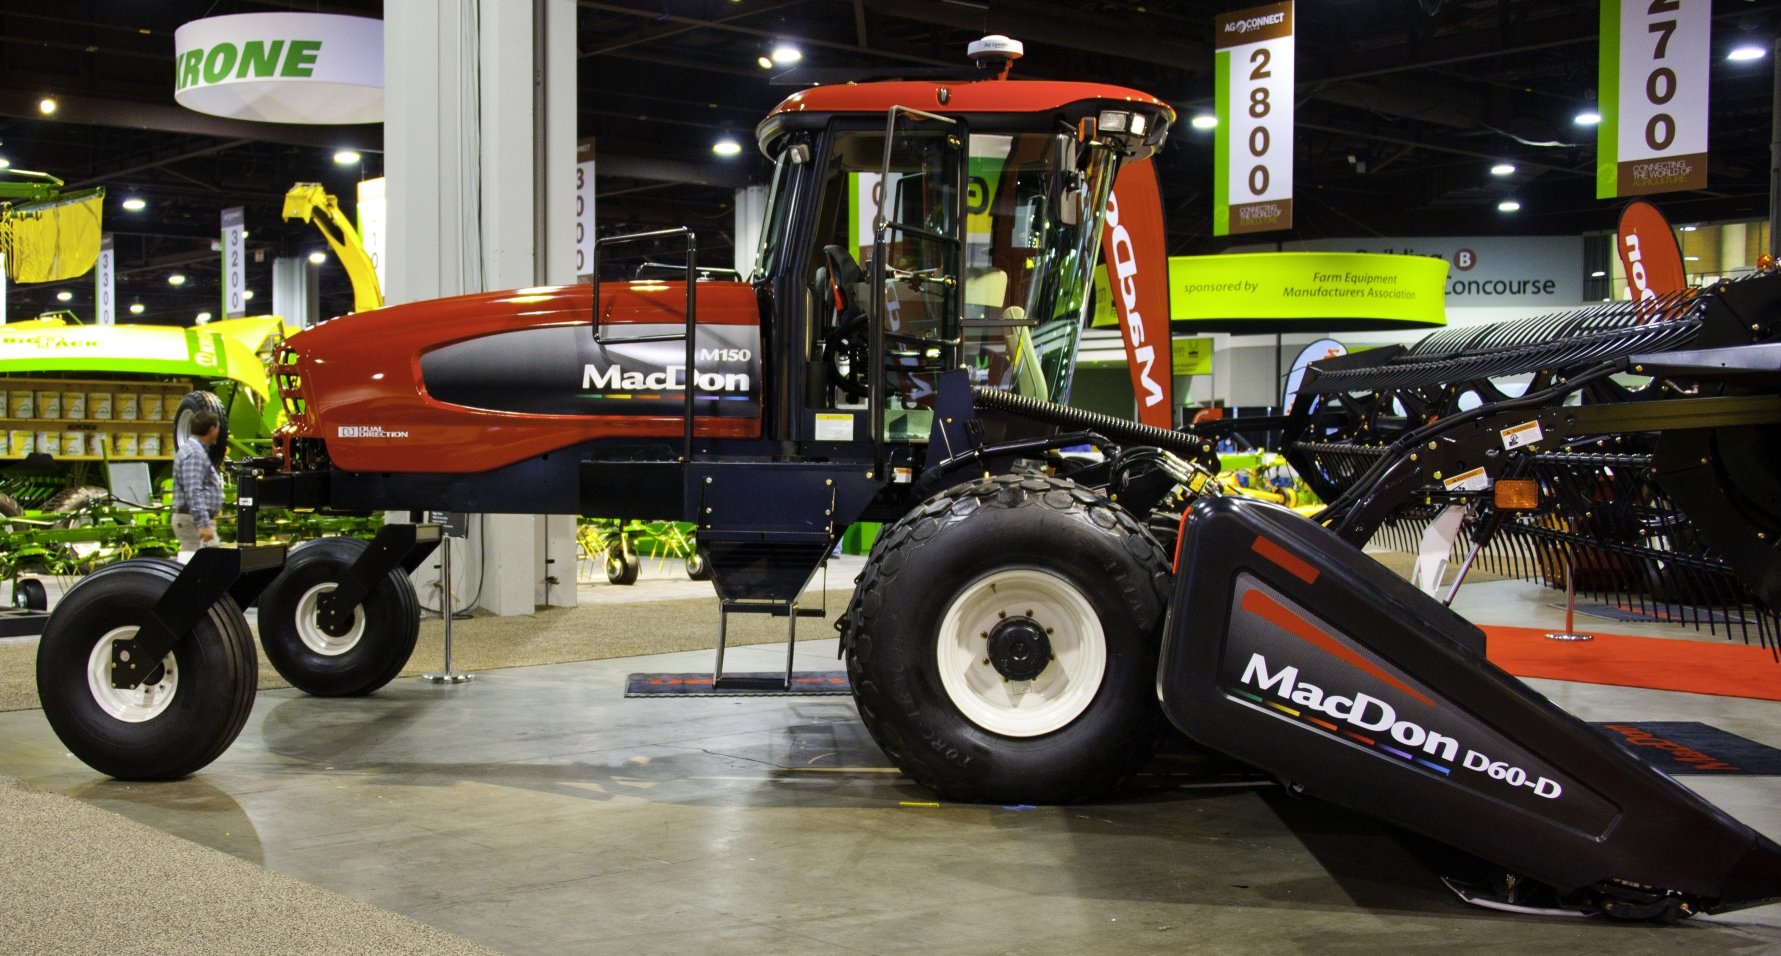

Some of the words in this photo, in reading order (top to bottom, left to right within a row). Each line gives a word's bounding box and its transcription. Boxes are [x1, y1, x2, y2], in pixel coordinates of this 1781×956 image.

[1246, 12, 1285, 29] CONNECT
[176, 40, 322, 90] KRONE
[1248, 48, 1271, 196] 2800
[1632, 171, 1648, 180] THE
[1650, 168, 1680, 178] WORLD
[1681, 166, 1692, 175] OF
[1633, 160, 1686, 172] CONNECTING
[1459, 252, 1471, 267] B
[231, 229, 239, 309] 3200
[1313, 272, 1342, 282] Farm
[1345, 272, 1397, 286] Equipment
[1184, 281, 1241, 294] sponsored
[1244, 280, 1258, 293] by
[1283, 286, 1365, 298] Manufacturers
[1367, 289, 1416, 300] Association
[700, 348, 751, 362] M150
[582, 363, 750, 391] MacDon
[1241, 652, 1459, 762] MacDon
[1462, 749, 1562, 799] D60-D
